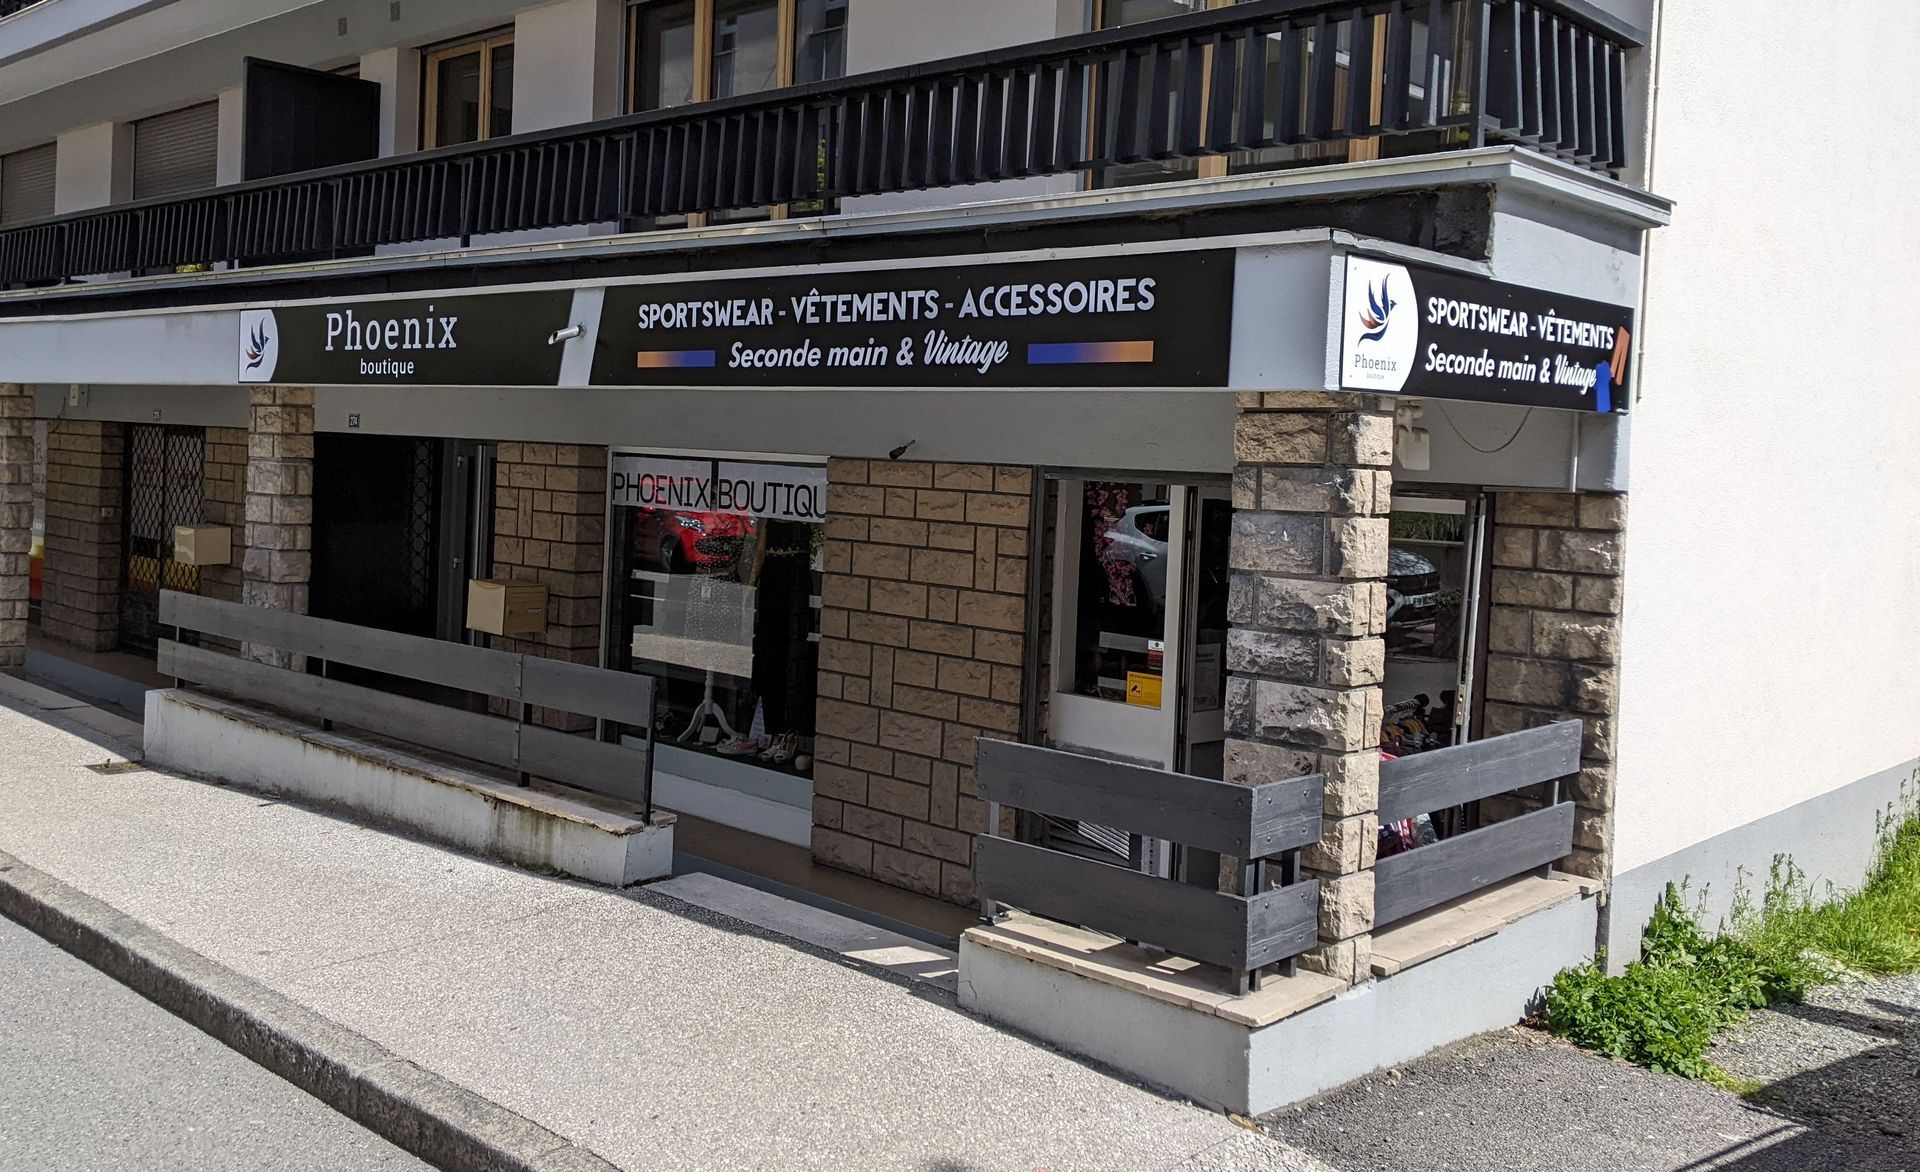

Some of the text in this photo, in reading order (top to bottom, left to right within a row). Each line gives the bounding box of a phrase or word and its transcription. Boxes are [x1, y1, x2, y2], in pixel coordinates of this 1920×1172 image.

[638, 298, 774, 329] SPORTSWEAR
[791, 288, 940, 324] VÊTEMENTS
[959, 277, 1156, 318] ACCESSOIRES
[1427, 296, 1528, 338] SPORTSWEAR
[1538, 308, 1614, 350] VÊTEMENTS
[325, 305, 458, 351] Phoenix
[360, 358, 414, 378] boutique
[728, 329, 1009, 374] Seconde main & Vintage
[1354, 354, 1397, 372] Phoenix
[1425, 342, 1598, 395] Seconde main & Vintage
[612, 472, 711, 508] PHOENIX
